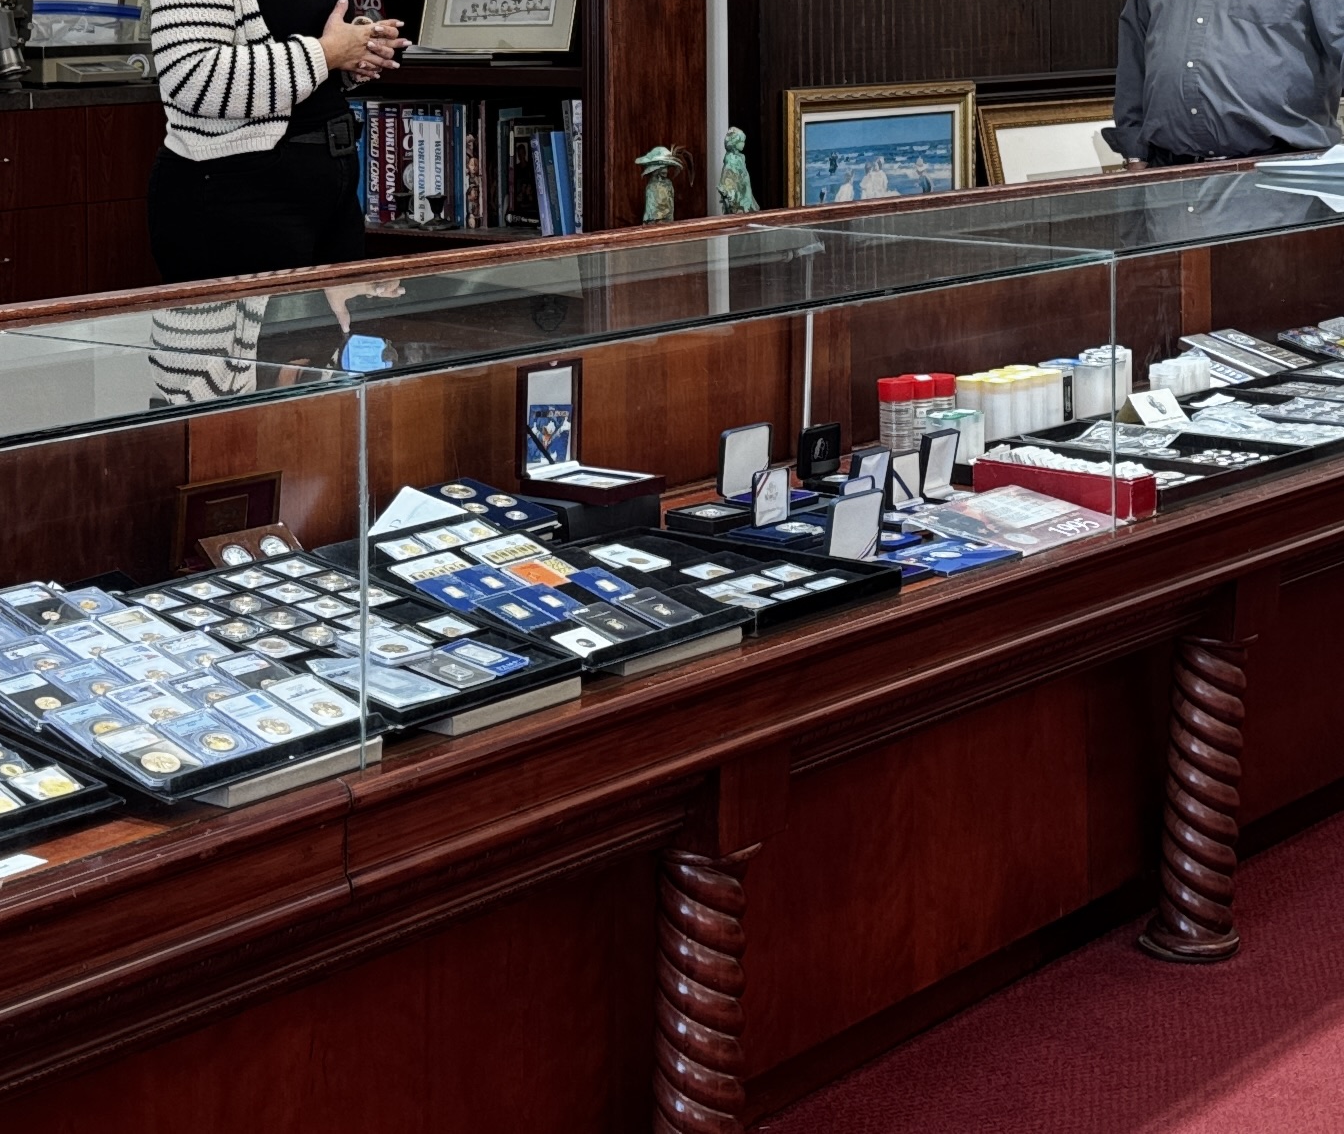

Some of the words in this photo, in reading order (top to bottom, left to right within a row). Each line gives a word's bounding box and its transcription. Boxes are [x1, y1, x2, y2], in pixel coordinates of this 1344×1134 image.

[370, 117, 379, 158] WORLD
[385, 117, 395, 162] WORLD
[385, 164, 396, 202] COINS
[1048, 517, 1101, 537] 1995
